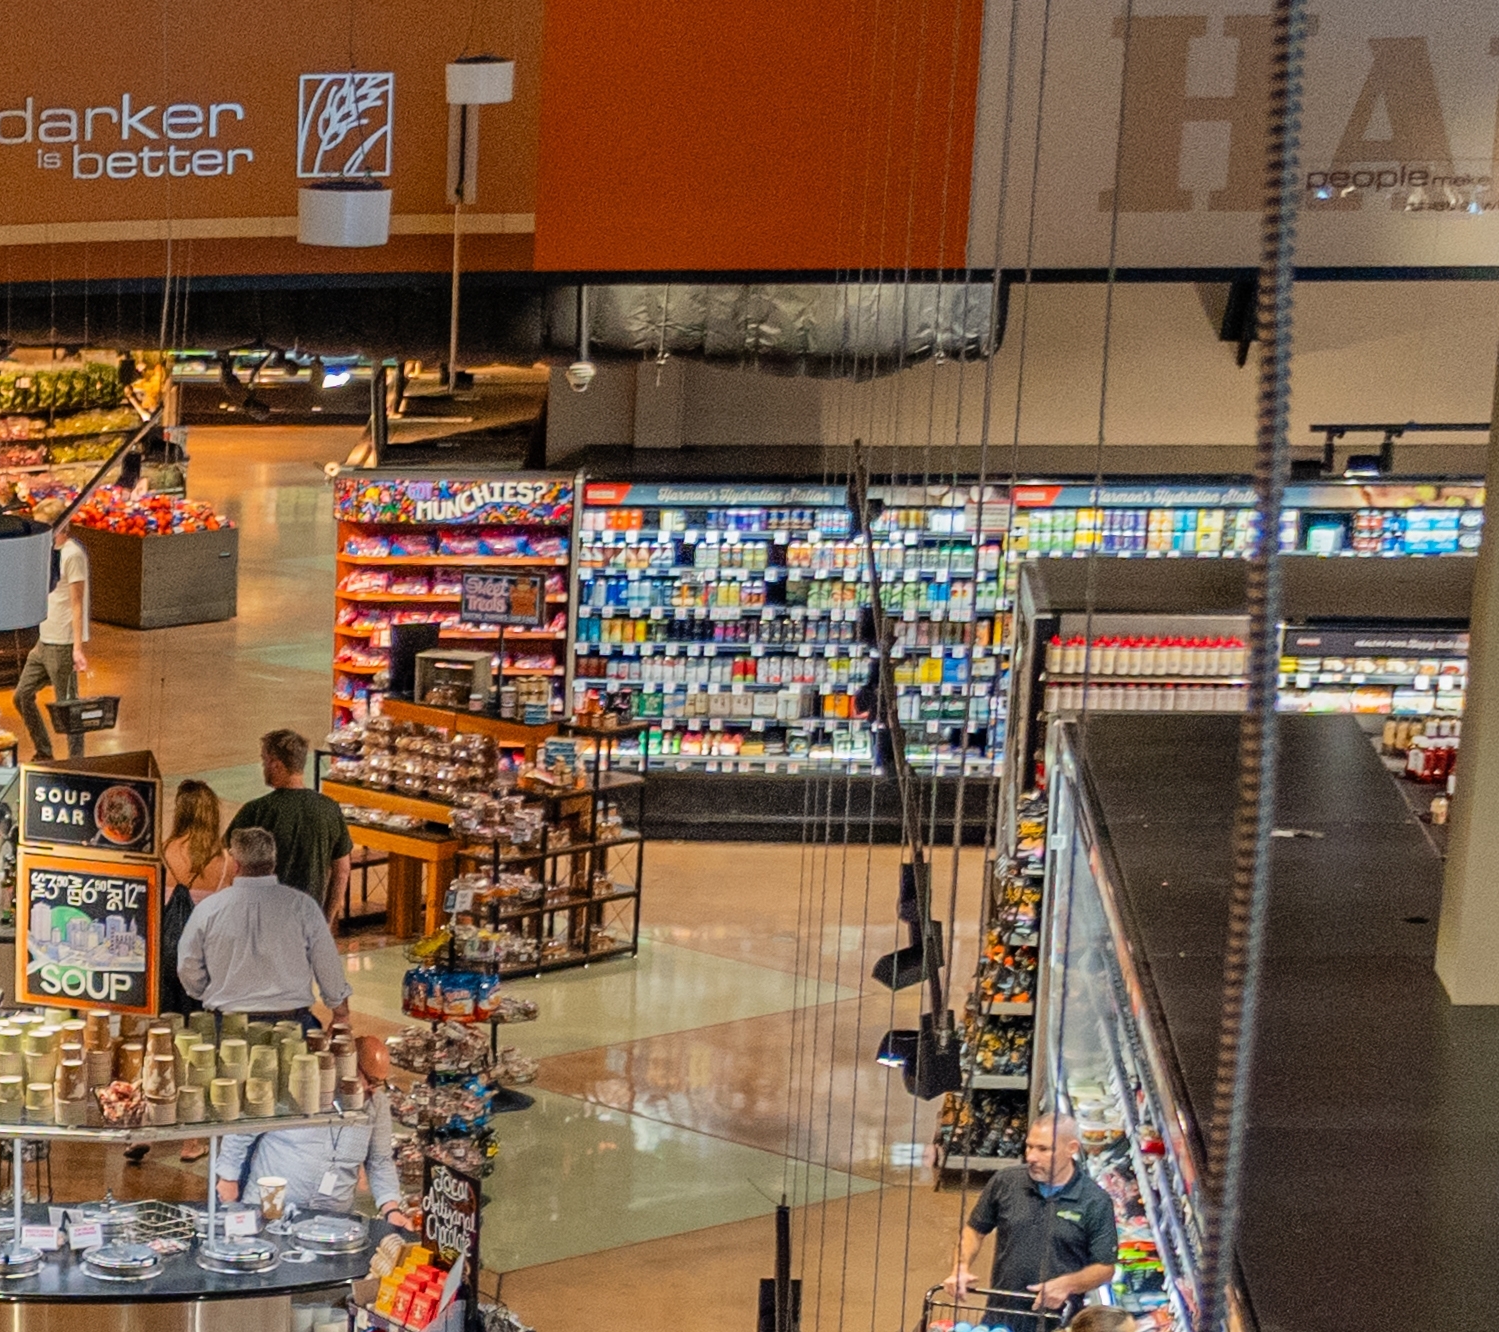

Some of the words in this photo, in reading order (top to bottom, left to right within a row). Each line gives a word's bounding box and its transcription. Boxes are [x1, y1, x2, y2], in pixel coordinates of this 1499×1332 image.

[37, 148, 63, 171] is
[73, 144, 253, 180] better
[1306, 166, 1429, 191] people
[415, 481, 547, 522] MUNCHIES?
[719, 485, 782, 505] Hydration
[784, 487, 831, 504] Station
[35, 786, 92, 806] SOUP
[41, 806, 85, 825] BAR
[107, 880, 123, 911] LRG
[41, 964, 132, 1000] SOUP
[432, 1165, 471, 1200] Local
[426, 1216, 472, 1253] Chocolate
